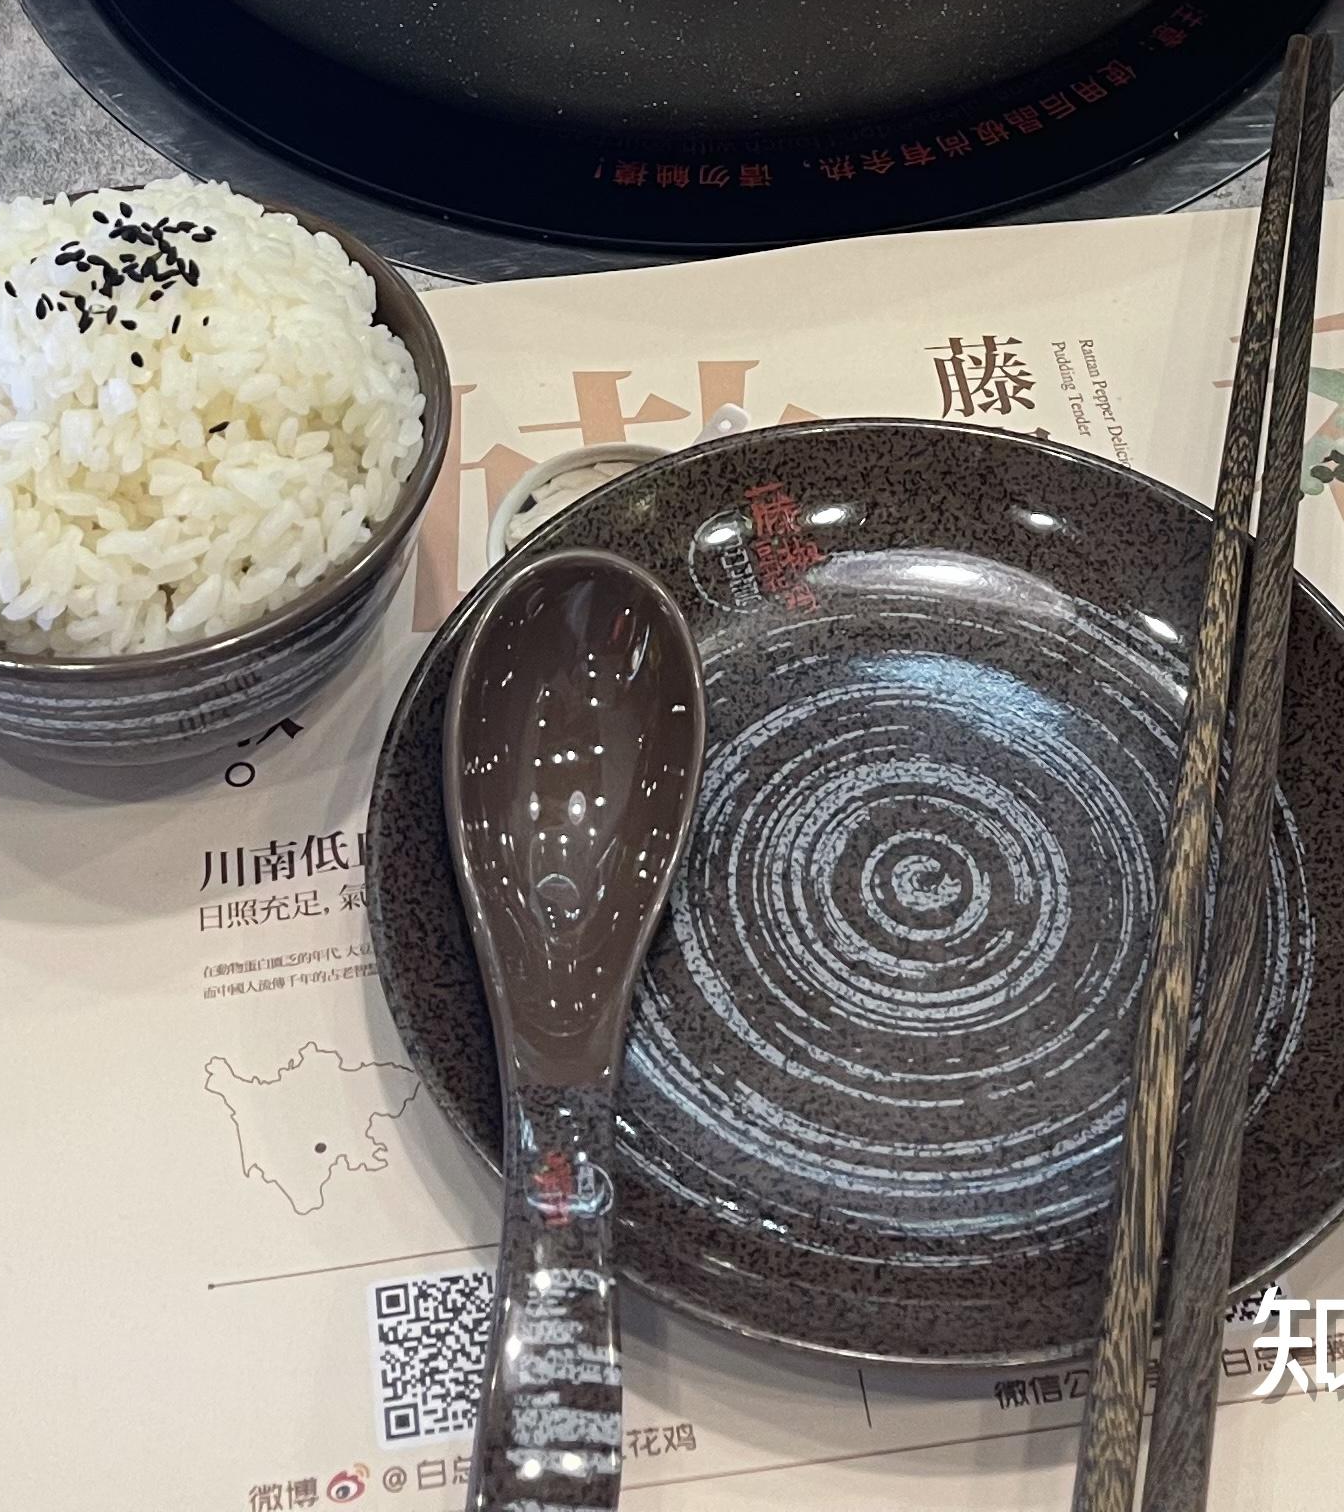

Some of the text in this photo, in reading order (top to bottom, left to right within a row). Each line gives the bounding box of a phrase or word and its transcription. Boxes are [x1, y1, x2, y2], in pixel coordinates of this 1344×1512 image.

[1052, 340, 1092, 438] Pudding Tender
[1078, 338, 1101, 379] Rattan
[1092, 380, 1116, 423] Pepper
[199, 830, 367, 892] 川南低
[624, 1423, 697, 1461] 花鸡
[249, 1477, 318, 1512] 微博
